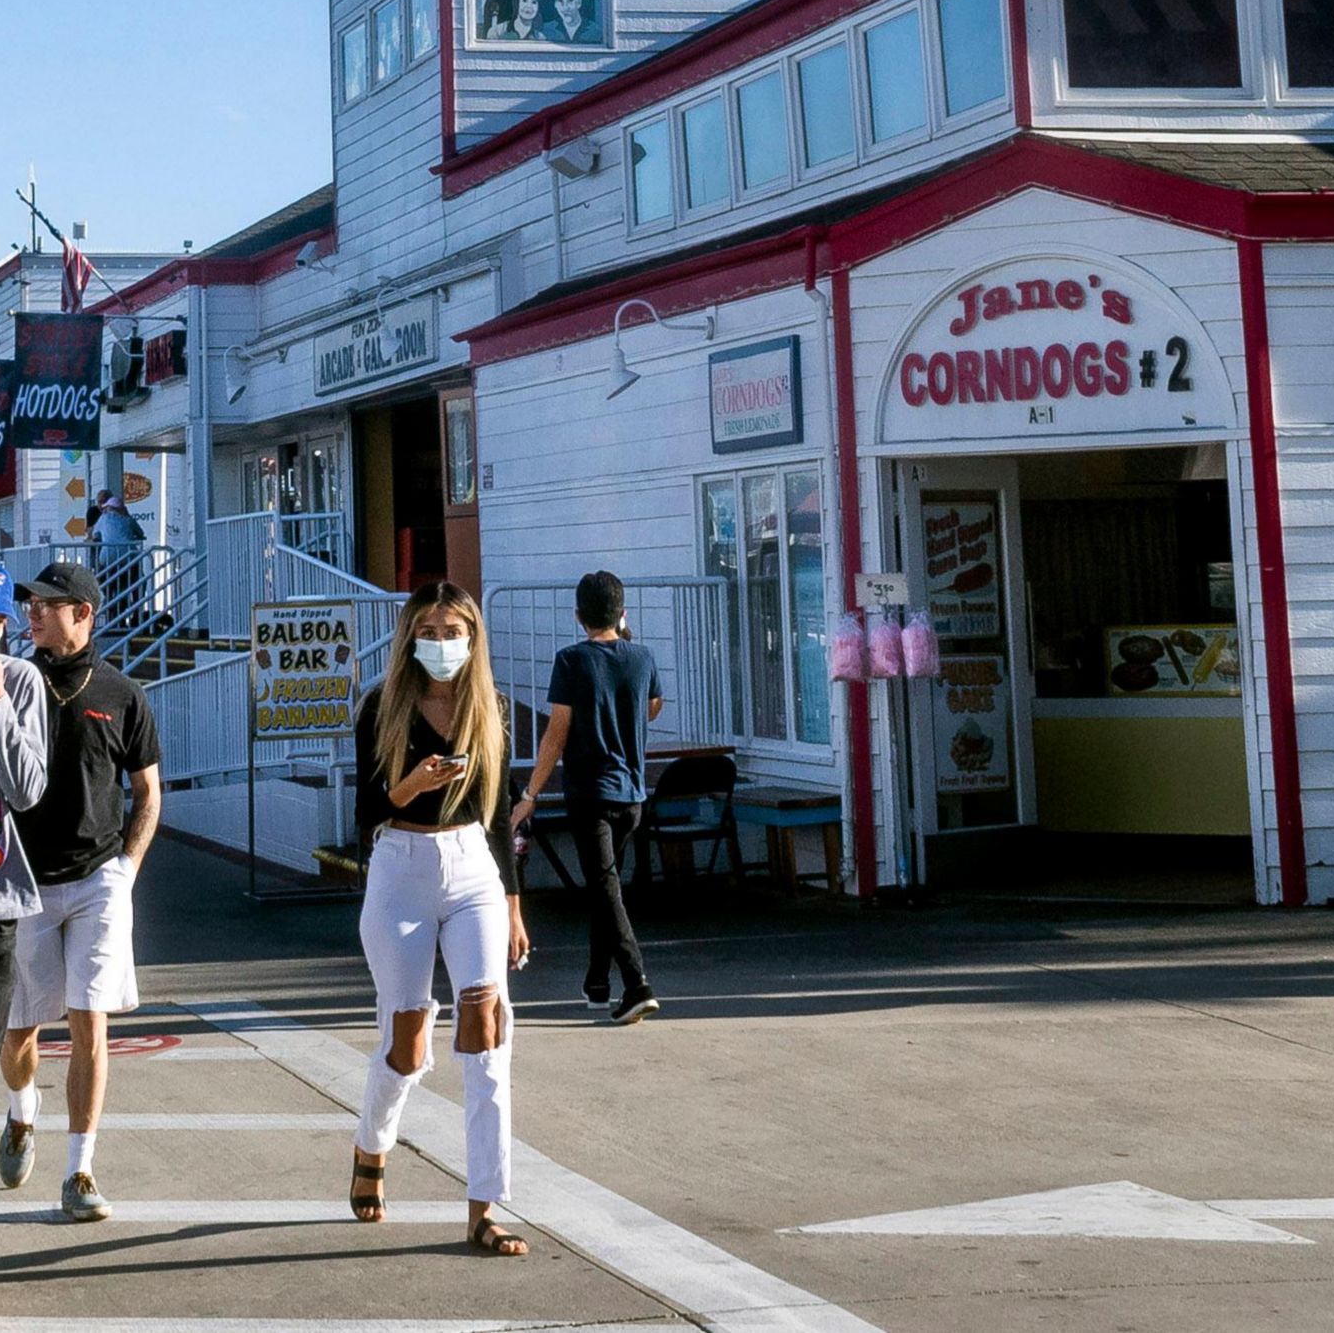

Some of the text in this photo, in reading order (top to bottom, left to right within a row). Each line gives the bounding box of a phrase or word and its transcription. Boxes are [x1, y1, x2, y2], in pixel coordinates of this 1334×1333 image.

[949, 274, 1135, 337] Jane's
[351, 321, 366, 340] FUN
[319, 344, 355, 387] ARCADE
[900, 339, 1132, 408] CORNDOGS
[15, 383, 101, 421] HOTDOGS
[714, 375, 783, 415] CORNDOGS
[273, 609, 332, 619] Hand Dipped
[257, 620, 349, 645] BALBOA
[279, 649, 328, 670] BAR
[272, 676, 351, 703] FROZEN
[257, 702, 352, 732] BANANA
